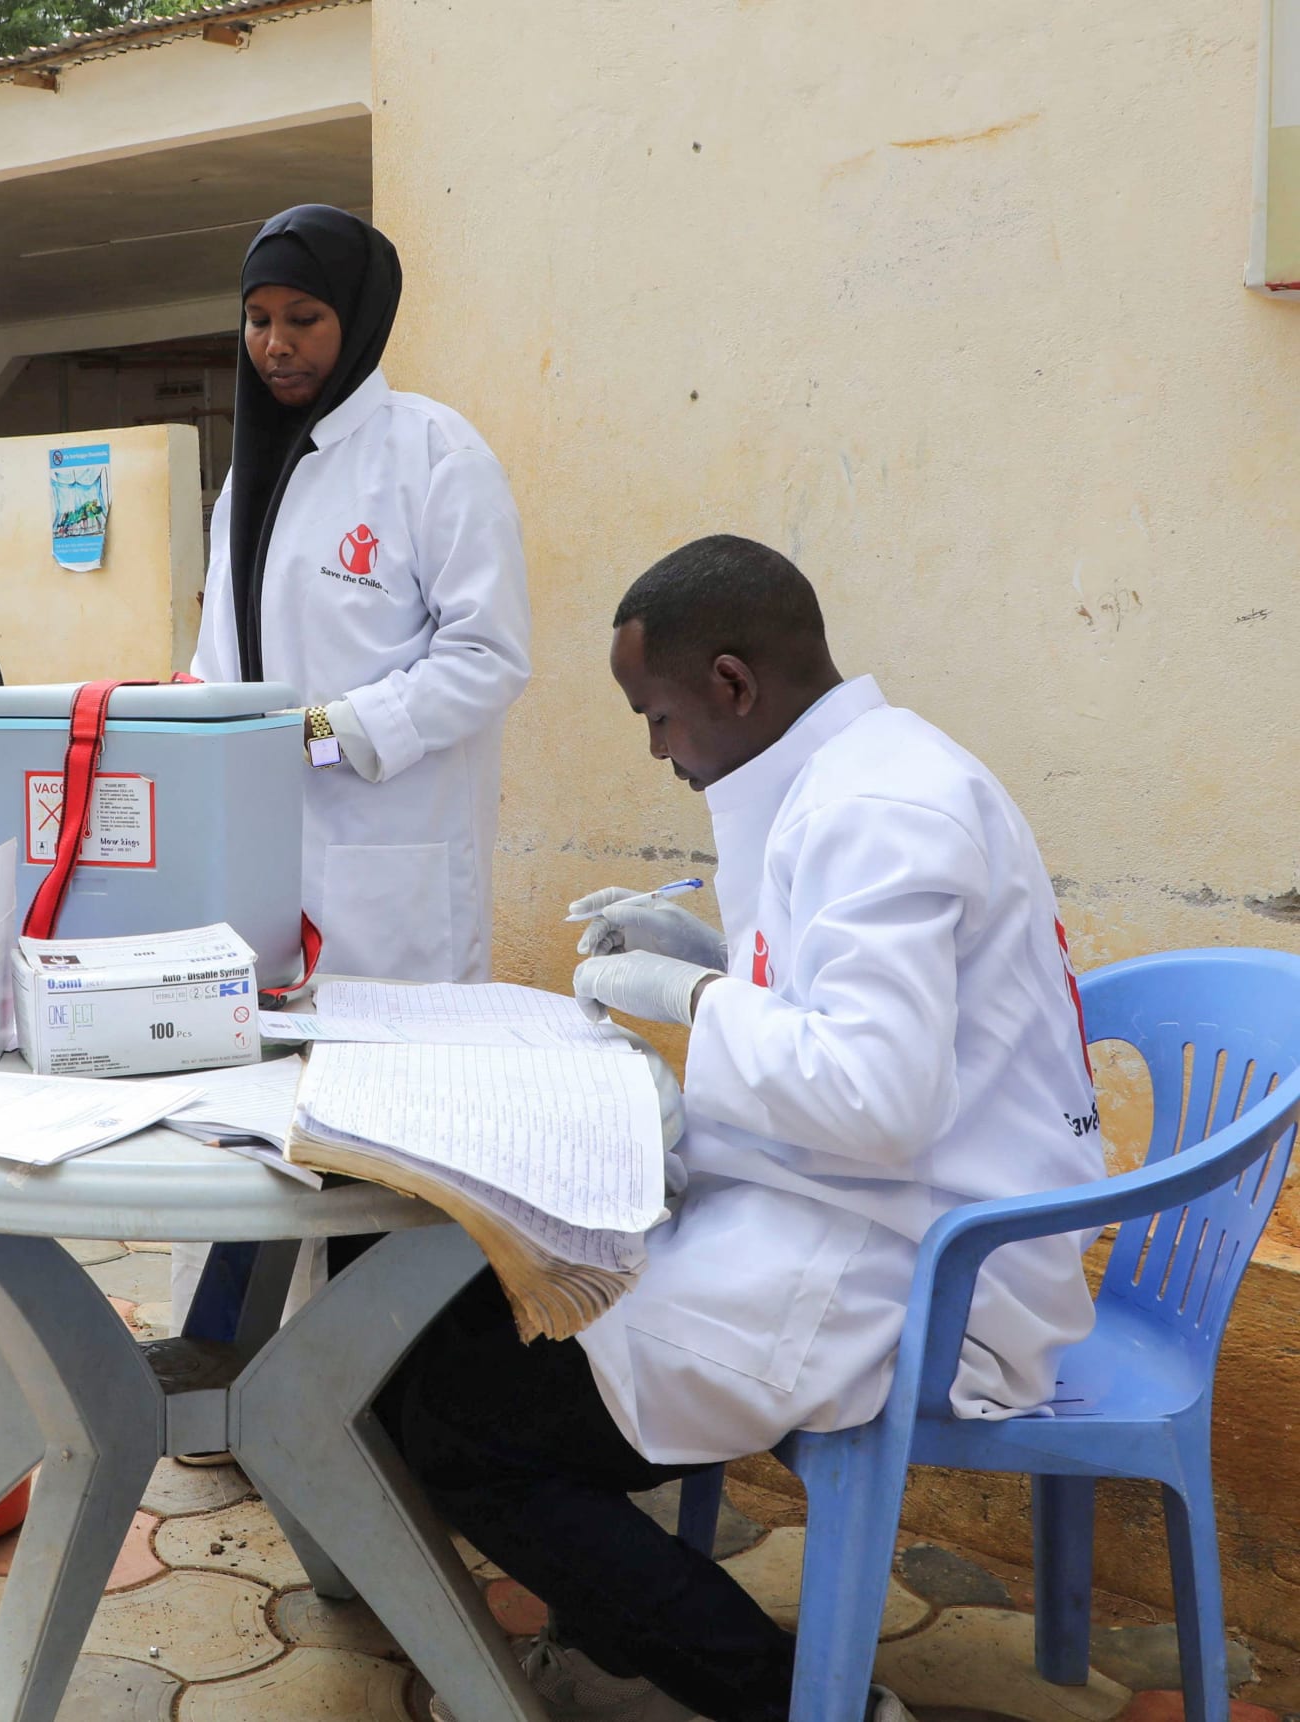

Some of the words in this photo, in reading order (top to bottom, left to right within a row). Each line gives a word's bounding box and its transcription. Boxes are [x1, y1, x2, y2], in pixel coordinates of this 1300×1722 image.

[320, 566, 341, 579] Save
[342, 575, 357, 583] the
[162, 974, 181, 983] Auto
[188, 970, 218, 980] Disable
[220, 967, 249, 979] Syringe
[47, 978, 82, 989] 0.5ml
[149, 1021, 174, 1040] 100
